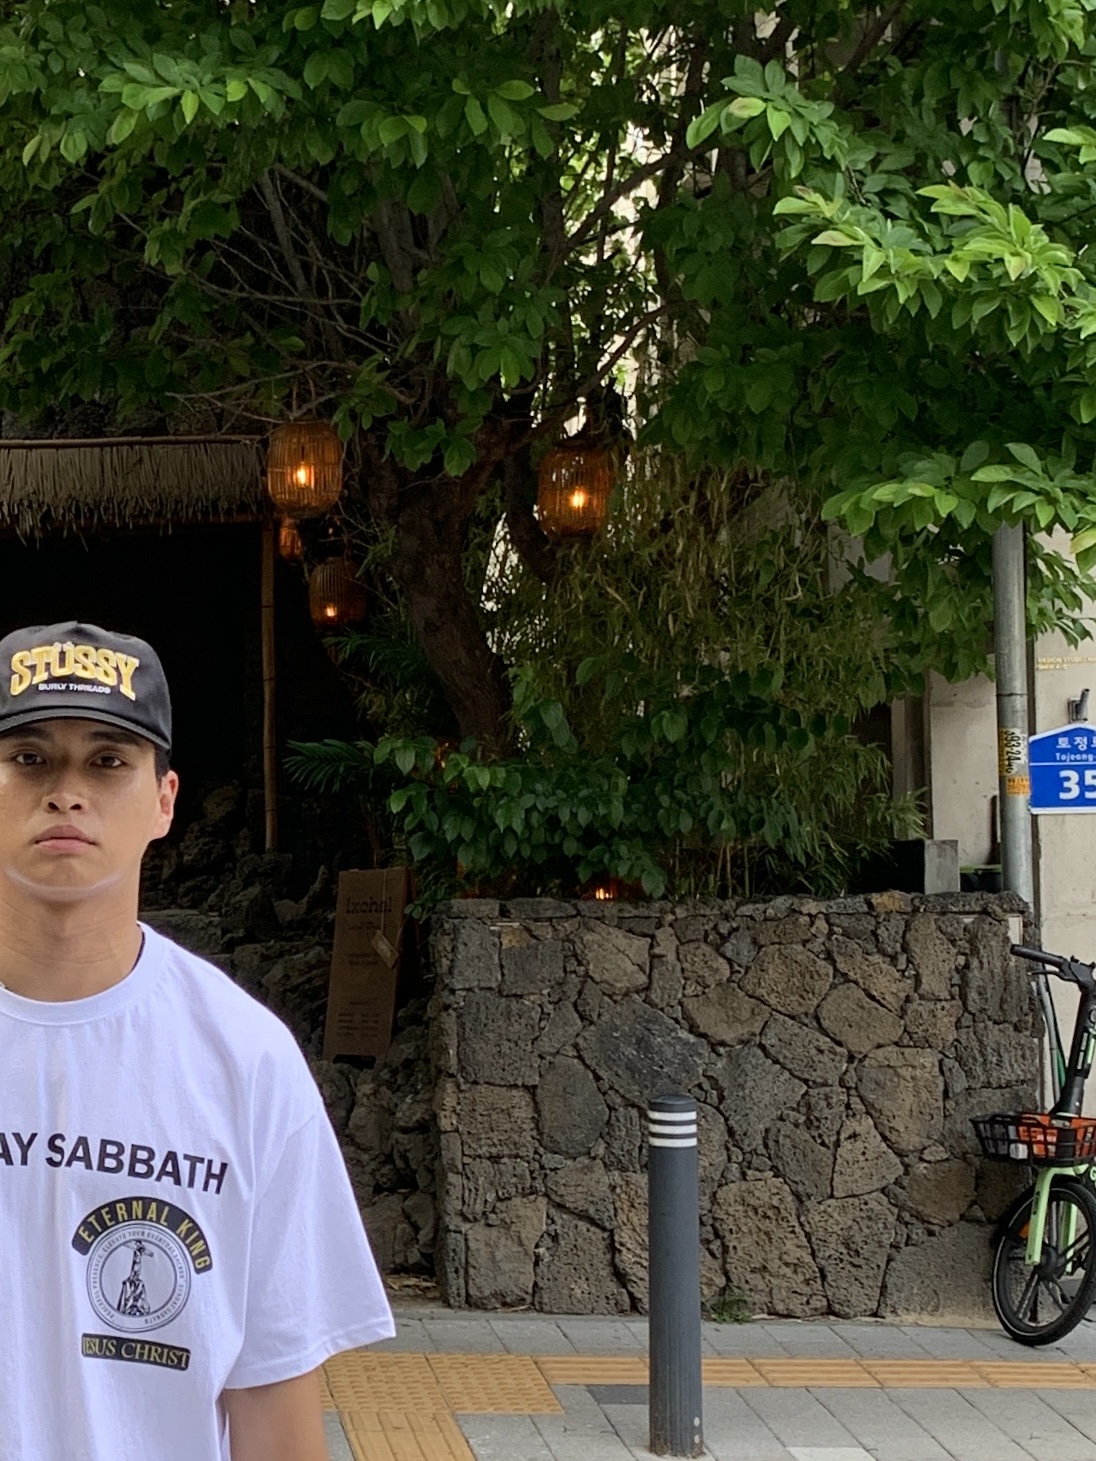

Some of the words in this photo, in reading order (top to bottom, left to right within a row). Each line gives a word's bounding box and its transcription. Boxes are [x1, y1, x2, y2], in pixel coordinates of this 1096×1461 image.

[10, 641, 140, 701] STÜSSY
[38, 683, 67, 691] BURLY
[69, 683, 112, 694] THREADS
[45, 1133, 229, 1195] SABBATH
[78, 1200, 170, 1244] ETERNAL
[176, 1219, 210, 1269] KING
[121, 1342, 191, 1368] CHRIST
